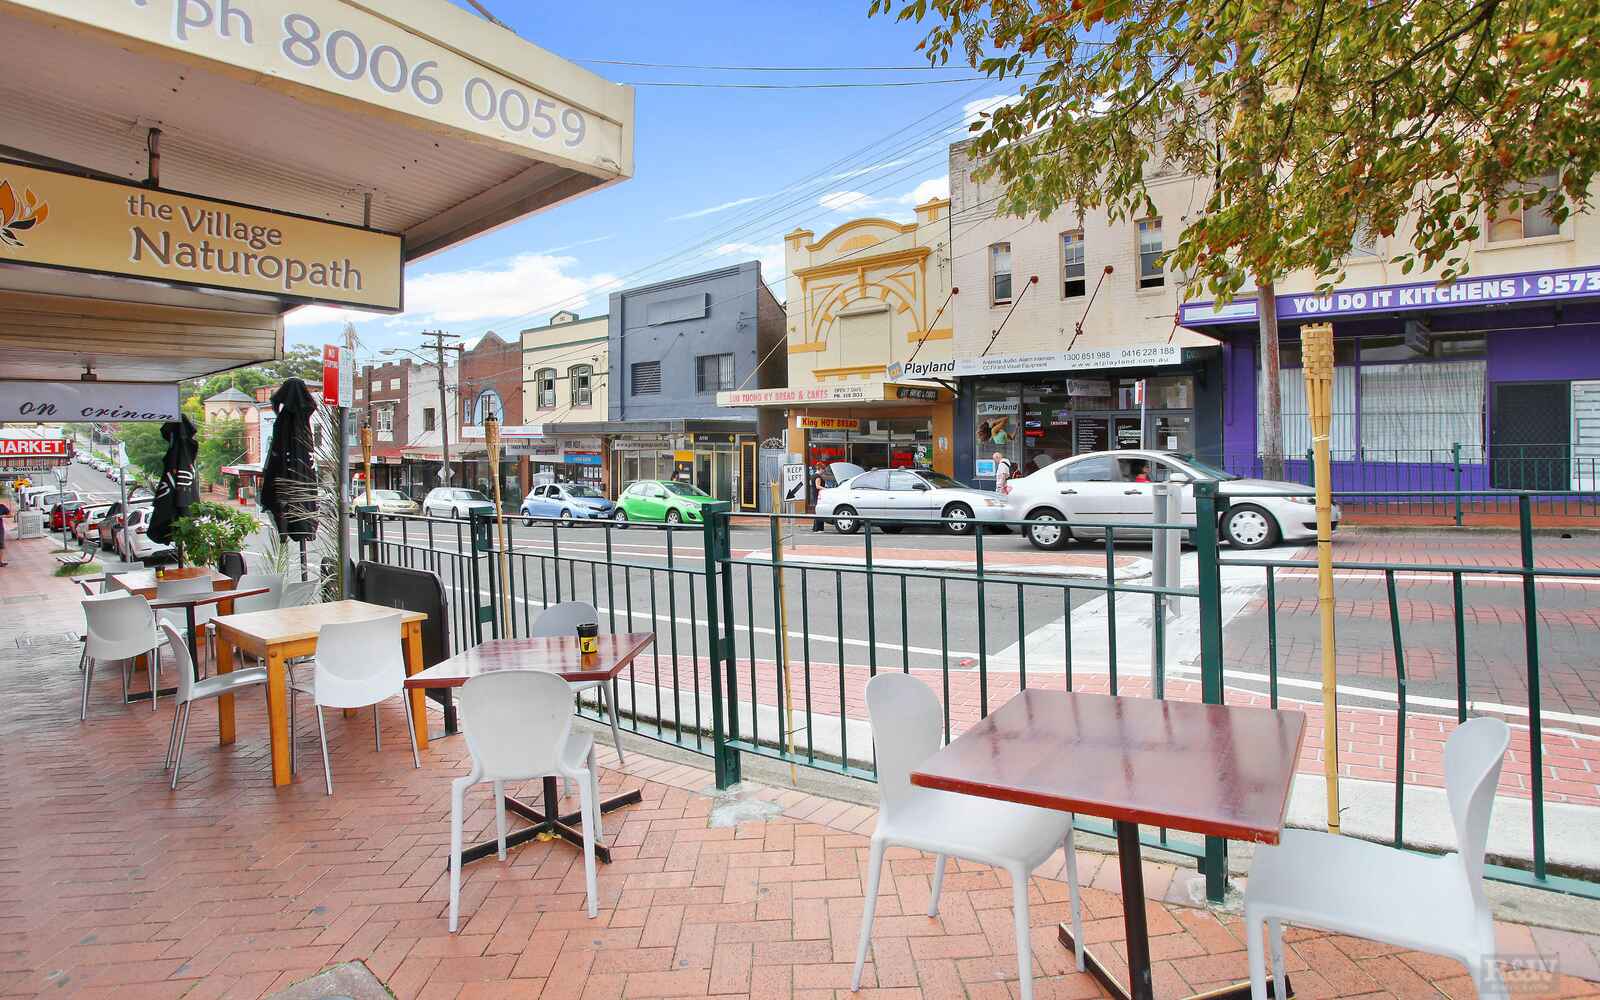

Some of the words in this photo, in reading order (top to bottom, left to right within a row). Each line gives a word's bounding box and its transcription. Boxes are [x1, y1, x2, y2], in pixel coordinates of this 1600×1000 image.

[281, 13, 443, 105] 8006
[463, 77, 586, 147] 0059
[128, 194, 173, 220] the
[180, 206, 282, 249] Village
[130, 226, 362, 290] Naturopath
[1294, 295, 1332, 313] YOU
[1338, 293, 1362, 310] DO
[1372, 291, 1392, 308] IT
[1399, 280, 1516, 306] KITCHENS
[1537, 272, 1600, 294] 9573
[1122, 350, 1141, 358] 0416
[1143, 348, 1158, 356] 228
[904, 360, 956, 375] Playland
[19, 401, 57, 416] on
[81, 405, 175, 420] crinan
[987, 404, 1018, 412] Playland
[802, 418, 818, 427] King
[821, 418, 834, 427] HOT
